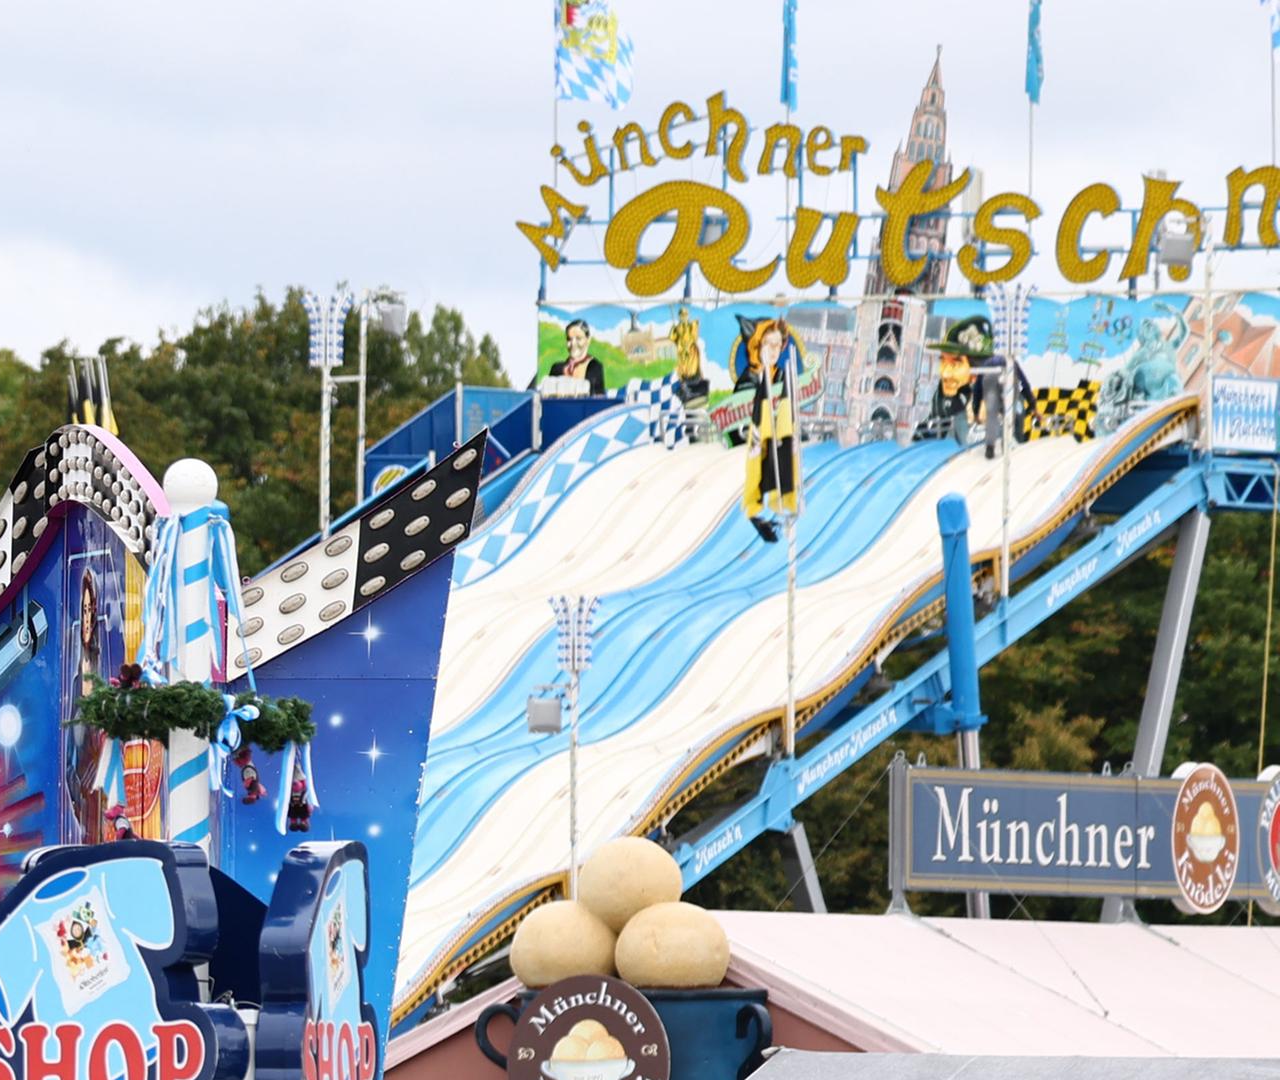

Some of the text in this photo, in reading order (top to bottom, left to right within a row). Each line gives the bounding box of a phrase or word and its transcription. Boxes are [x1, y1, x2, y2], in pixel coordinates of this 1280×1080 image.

[515, 90, 869, 271] Münchner
[931, 785, 1157, 870] Münchner
[1177, 849, 1236, 905] Knödelei
[528, 981, 648, 1036] Münchner
